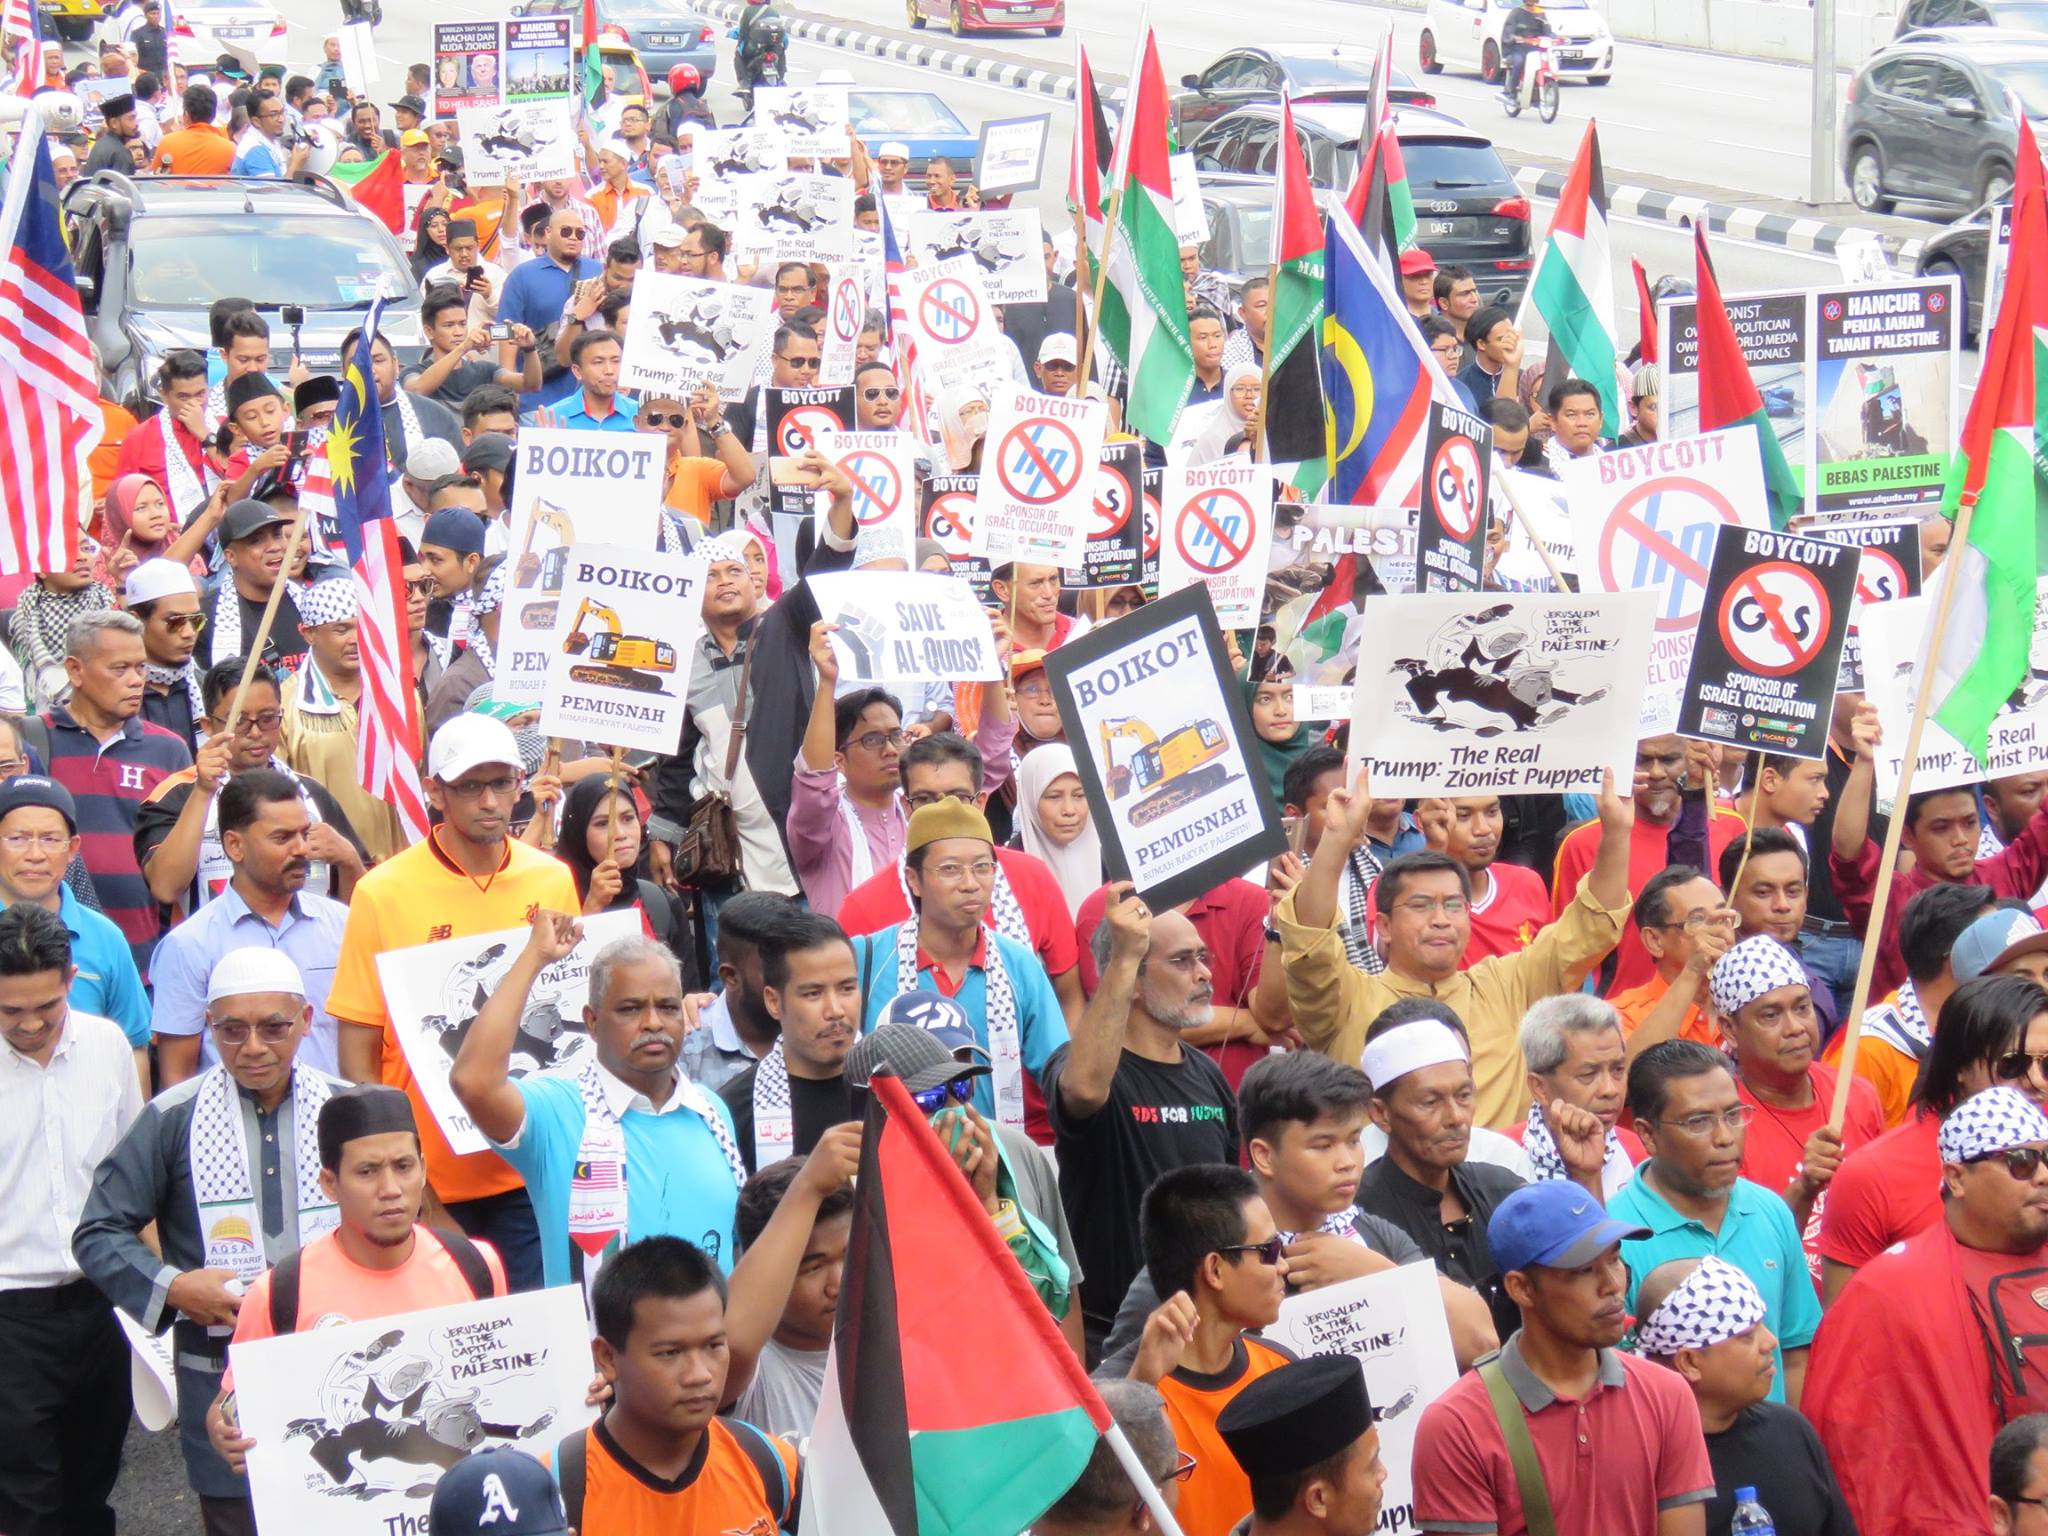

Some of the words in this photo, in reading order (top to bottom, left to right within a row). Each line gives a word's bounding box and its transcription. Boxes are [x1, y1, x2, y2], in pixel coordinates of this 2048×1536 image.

[440, 43, 464, 52] KUDA
[465, 41, 496, 50] ZIONIST
[476, 33, 495, 42] DAN
[438, 100, 450, 109] TO
[451, 100, 470, 108] HELL
[532, 168, 566, 180] Puppet!
[1177, 230, 1200, 242] ppet!
[1430, 223, 1454, 234] DAE7
[776, 240, 792, 248] The
[795, 240, 815, 248] Real
[776, 248, 808, 258] Zionist
[913, 260, 962, 284] BOYCOTT
[998, 290, 1038, 300] Puppet!
[1848, 292, 1920, 316] HANCUR
[1726, 304, 1762, 320] ONIST
[1734, 318, 1790, 333] POLITICIAN
[1736, 335, 1763, 348] ORLD
[1765, 332, 1798, 346] MEDIA
[1827, 336, 1870, 354] TANAH
[1874, 330, 1940, 350] PALESTINE
[300, 353, 340, 362] Amanah
[632, 365, 678, 383] Trump:
[678, 380, 711, 392] Zion
[682, 366, 704, 379] The
[706, 370, 725, 383] Real
[782, 390, 841, 404] BOYCOTT
[1014, 394, 1088, 420] BOYCOTT
[1441, 406, 1486, 444] BOYCOTT
[834, 434, 898, 449] BOYCOTT
[526, 444, 652, 480] BOIKOT
[1600, 434, 1725, 485] BOYCOTT
[1186, 468, 1255, 486] BOYCOTT
[1826, 468, 1868, 486] BEBAS
[1872, 462, 1941, 482] PALESTINE
[932, 478, 980, 492] BOYCOT
[1848, 493, 1919, 506] www.alquds.my
[1003, 504, 1046, 521] SPONSOR
[1048, 510, 1059, 522] OF
[984, 516, 1016, 531] ISRAEL
[1018, 520, 1074, 537] OCCUPATION
[1110, 539, 1122, 550] OF
[1292, 524, 1418, 558] PALEST
[1744, 530, 1841, 568] BOYCOTT
[1088, 548, 1136, 564] OCCUPATION
[1424, 550, 1450, 572] ISRAEL
[576, 562, 694, 598] BOIKOT
[954, 570, 991, 582] CCUPATION
[1229, 576, 1240, 586] OF
[1210, 586, 1256, 600] CCUPATION
[896, 601, 946, 632] SAVE
[1544, 609, 1600, 618] JERUSALEM
[1546, 626, 1592, 636] CAPITAL
[894, 636, 984, 676] AL-QUDS!
[1076, 629, 1200, 708] BOIKOT
[1725, 672, 1780, 696] SPONSOR
[1782, 682, 1798, 698] OF
[560, 694, 666, 723] PEMUSNAH
[1699, 684, 1742, 708] ISRAEL
[1744, 692, 1816, 720] OCCUPATION
[1200, 724, 1222, 744] CAT
[1999, 722, 2036, 748] Real
[1450, 746, 1488, 765] The
[1494, 744, 1542, 764] Real
[1890, 750, 1957, 776] Tump:
[120, 764, 145, 790] H
[1360, 756, 1444, 778] Trump:
[1444, 766, 1516, 788] Zionist
[1524, 766, 1604, 787] Puppet
[1136, 798, 1249, 866] PEMUSNAH
[540, 966, 590, 986] PALESTI
[1160, 1106, 1188, 1123] FOR
[206, 1258, 230, 1266] AQSA
[232, 1254, 262, 1266] SYARIF
[1303, 1298, 1369, 1326] JERUSALEM
[443, 1316, 512, 1340] JERUSALEM
[1310, 1324, 1324, 1336] IS
[1326, 1316, 1352, 1330] THE
[1312, 1325, 1366, 1345] CAPITAL
[450, 1336, 464, 1347] IS
[468, 1332, 494, 1344] THE
[452, 1340, 508, 1357] CAPITAL
[1330, 1336, 1348, 1348] OF
[450, 1349, 548, 1380] PALESTINE!
[470, 1352, 488, 1364] OF
[479, 1473, 519, 1528] A
